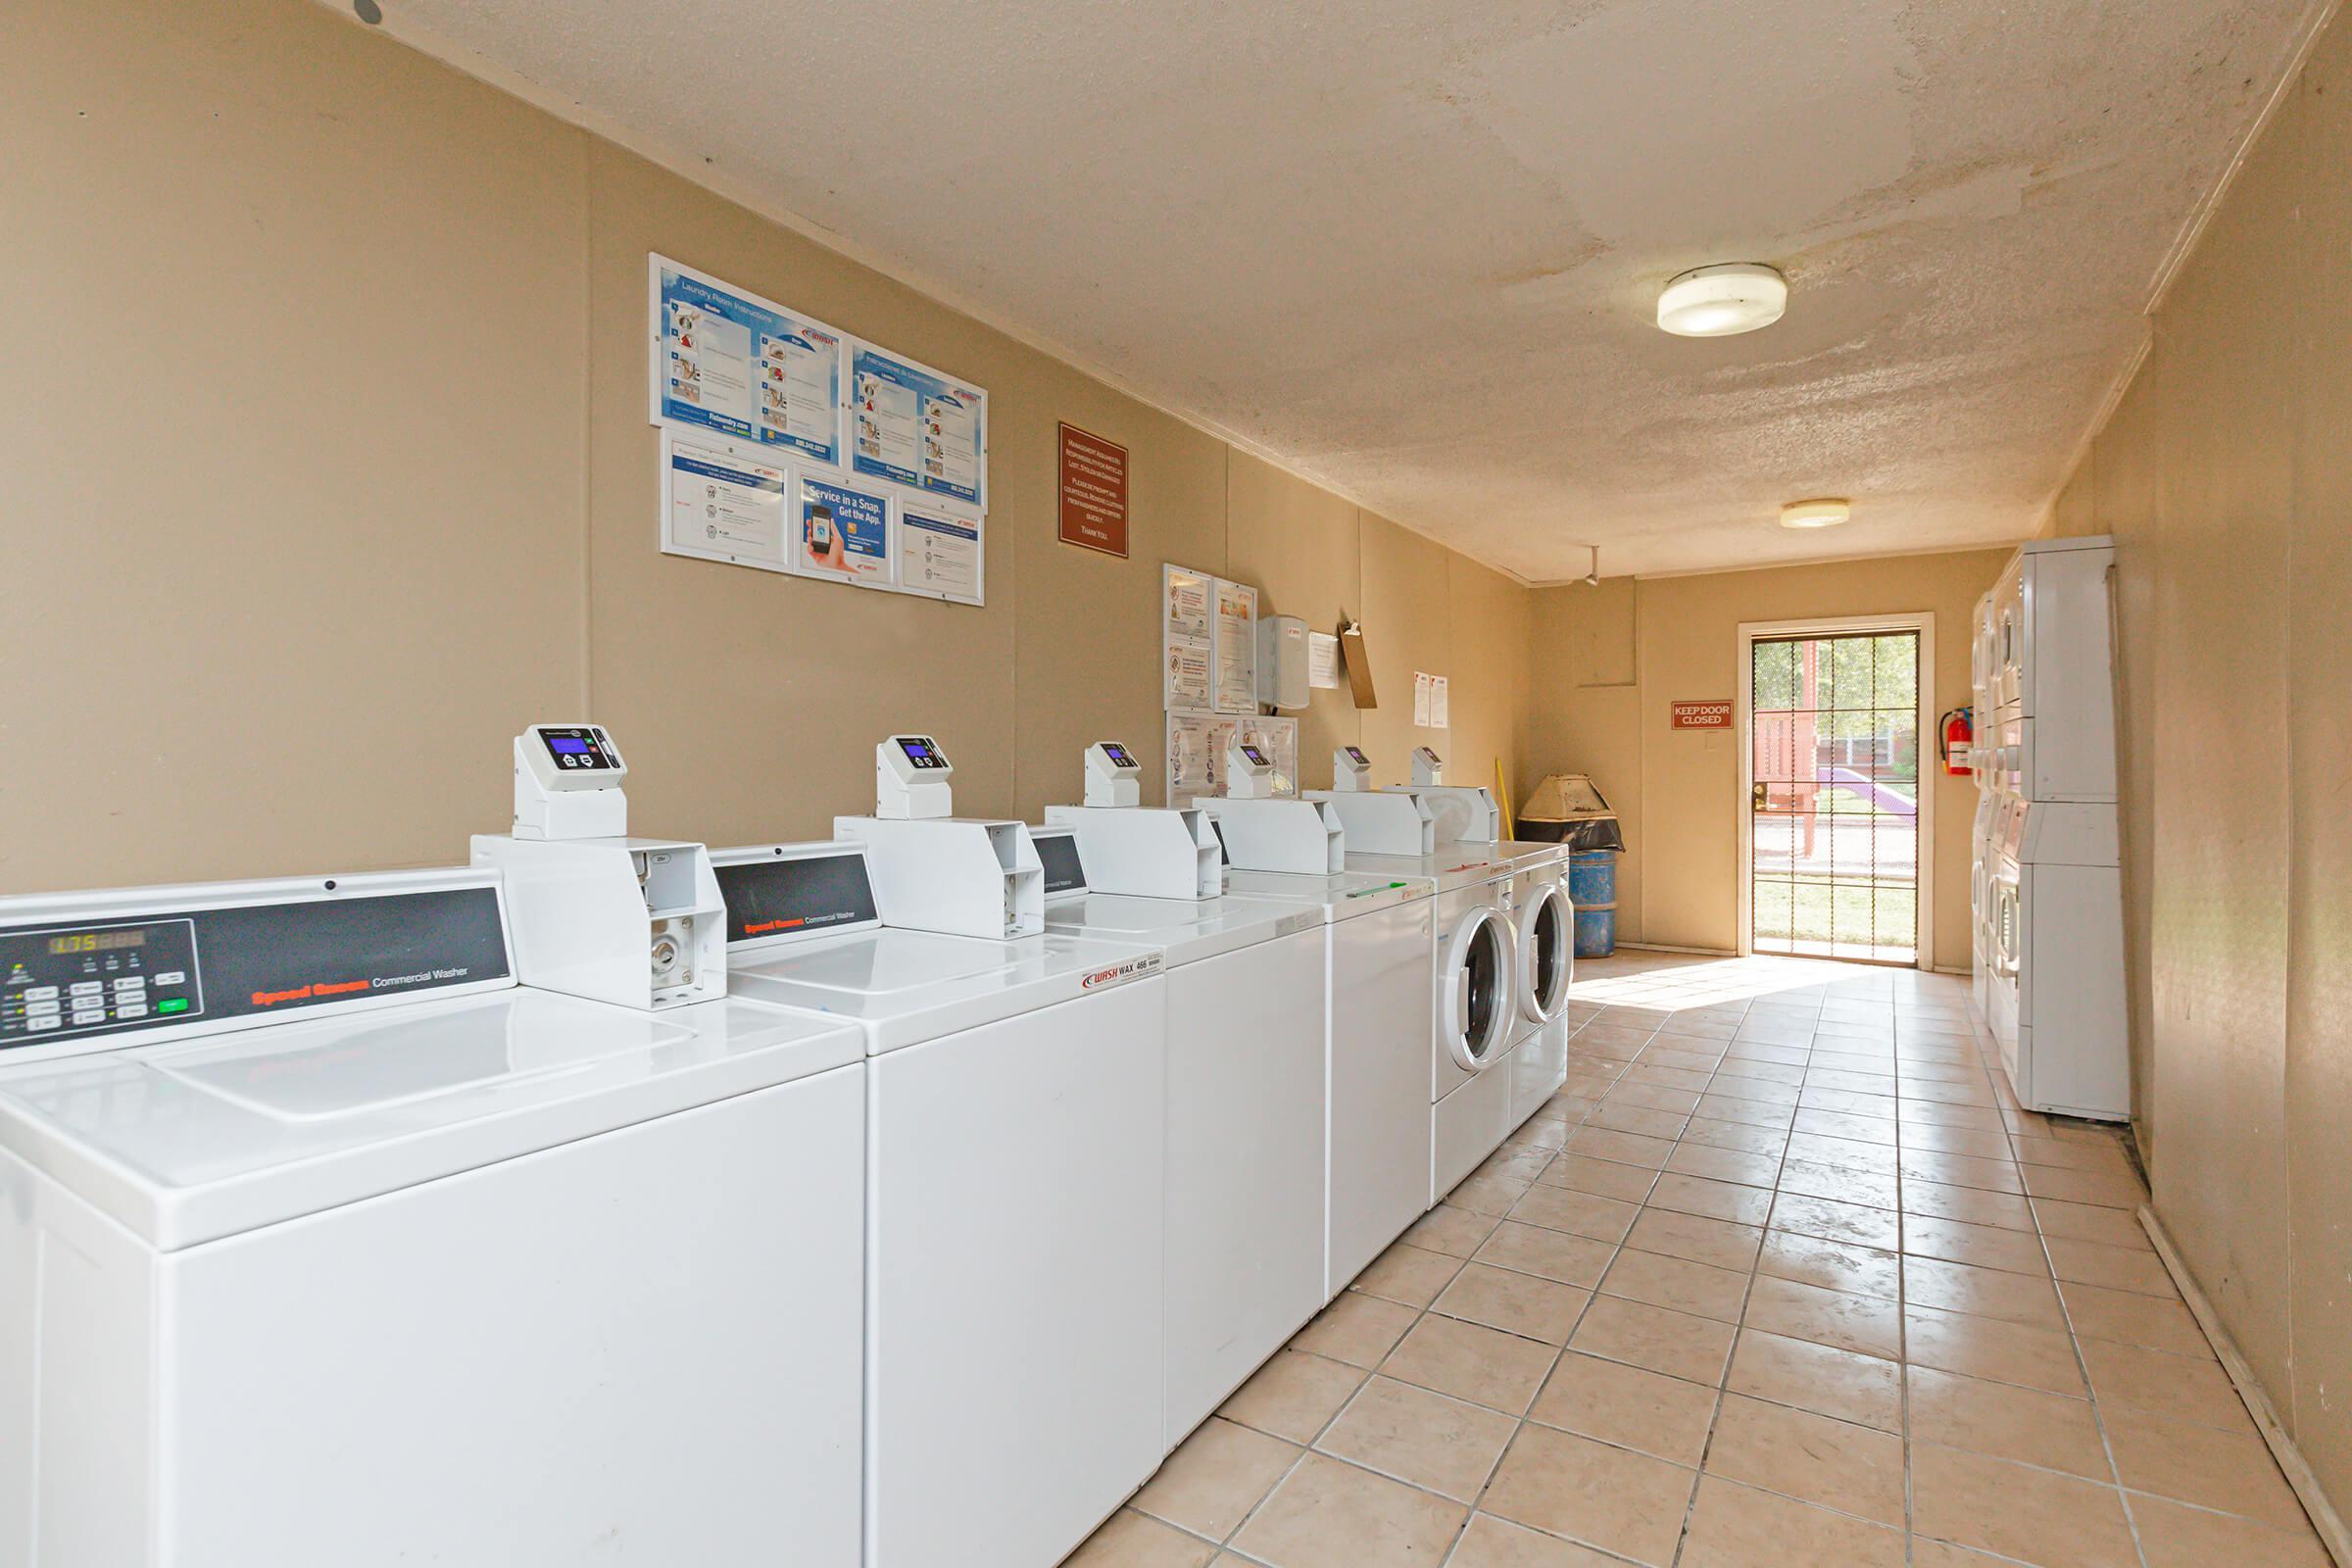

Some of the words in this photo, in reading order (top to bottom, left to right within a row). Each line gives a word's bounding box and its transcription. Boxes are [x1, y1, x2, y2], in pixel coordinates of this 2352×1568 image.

[682, 280, 710, 300] Laundry
[712, 293, 734, 309] Room
[809, 485, 841, 504] Service
[843, 494, 851, 506] in
[852, 499, 858, 508] a
[858, 498, 881, 514] Snap.
[839, 506, 852, 517] Get
[853, 510, 864, 521] the
[864, 513, 881, 525] App.
[1676, 707, 1699, 715] KEEP
[1682, 715, 1722, 724] CLOSED
[806, 914, 836, 925] Commercial
[1094, 966, 1118, 983] WASH
[1119, 964, 1134, 974] WAX
[251, 986, 312, 1005] Speed
[372, 971, 431, 989] Commercial
[431, 966, 468, 981] Washer
